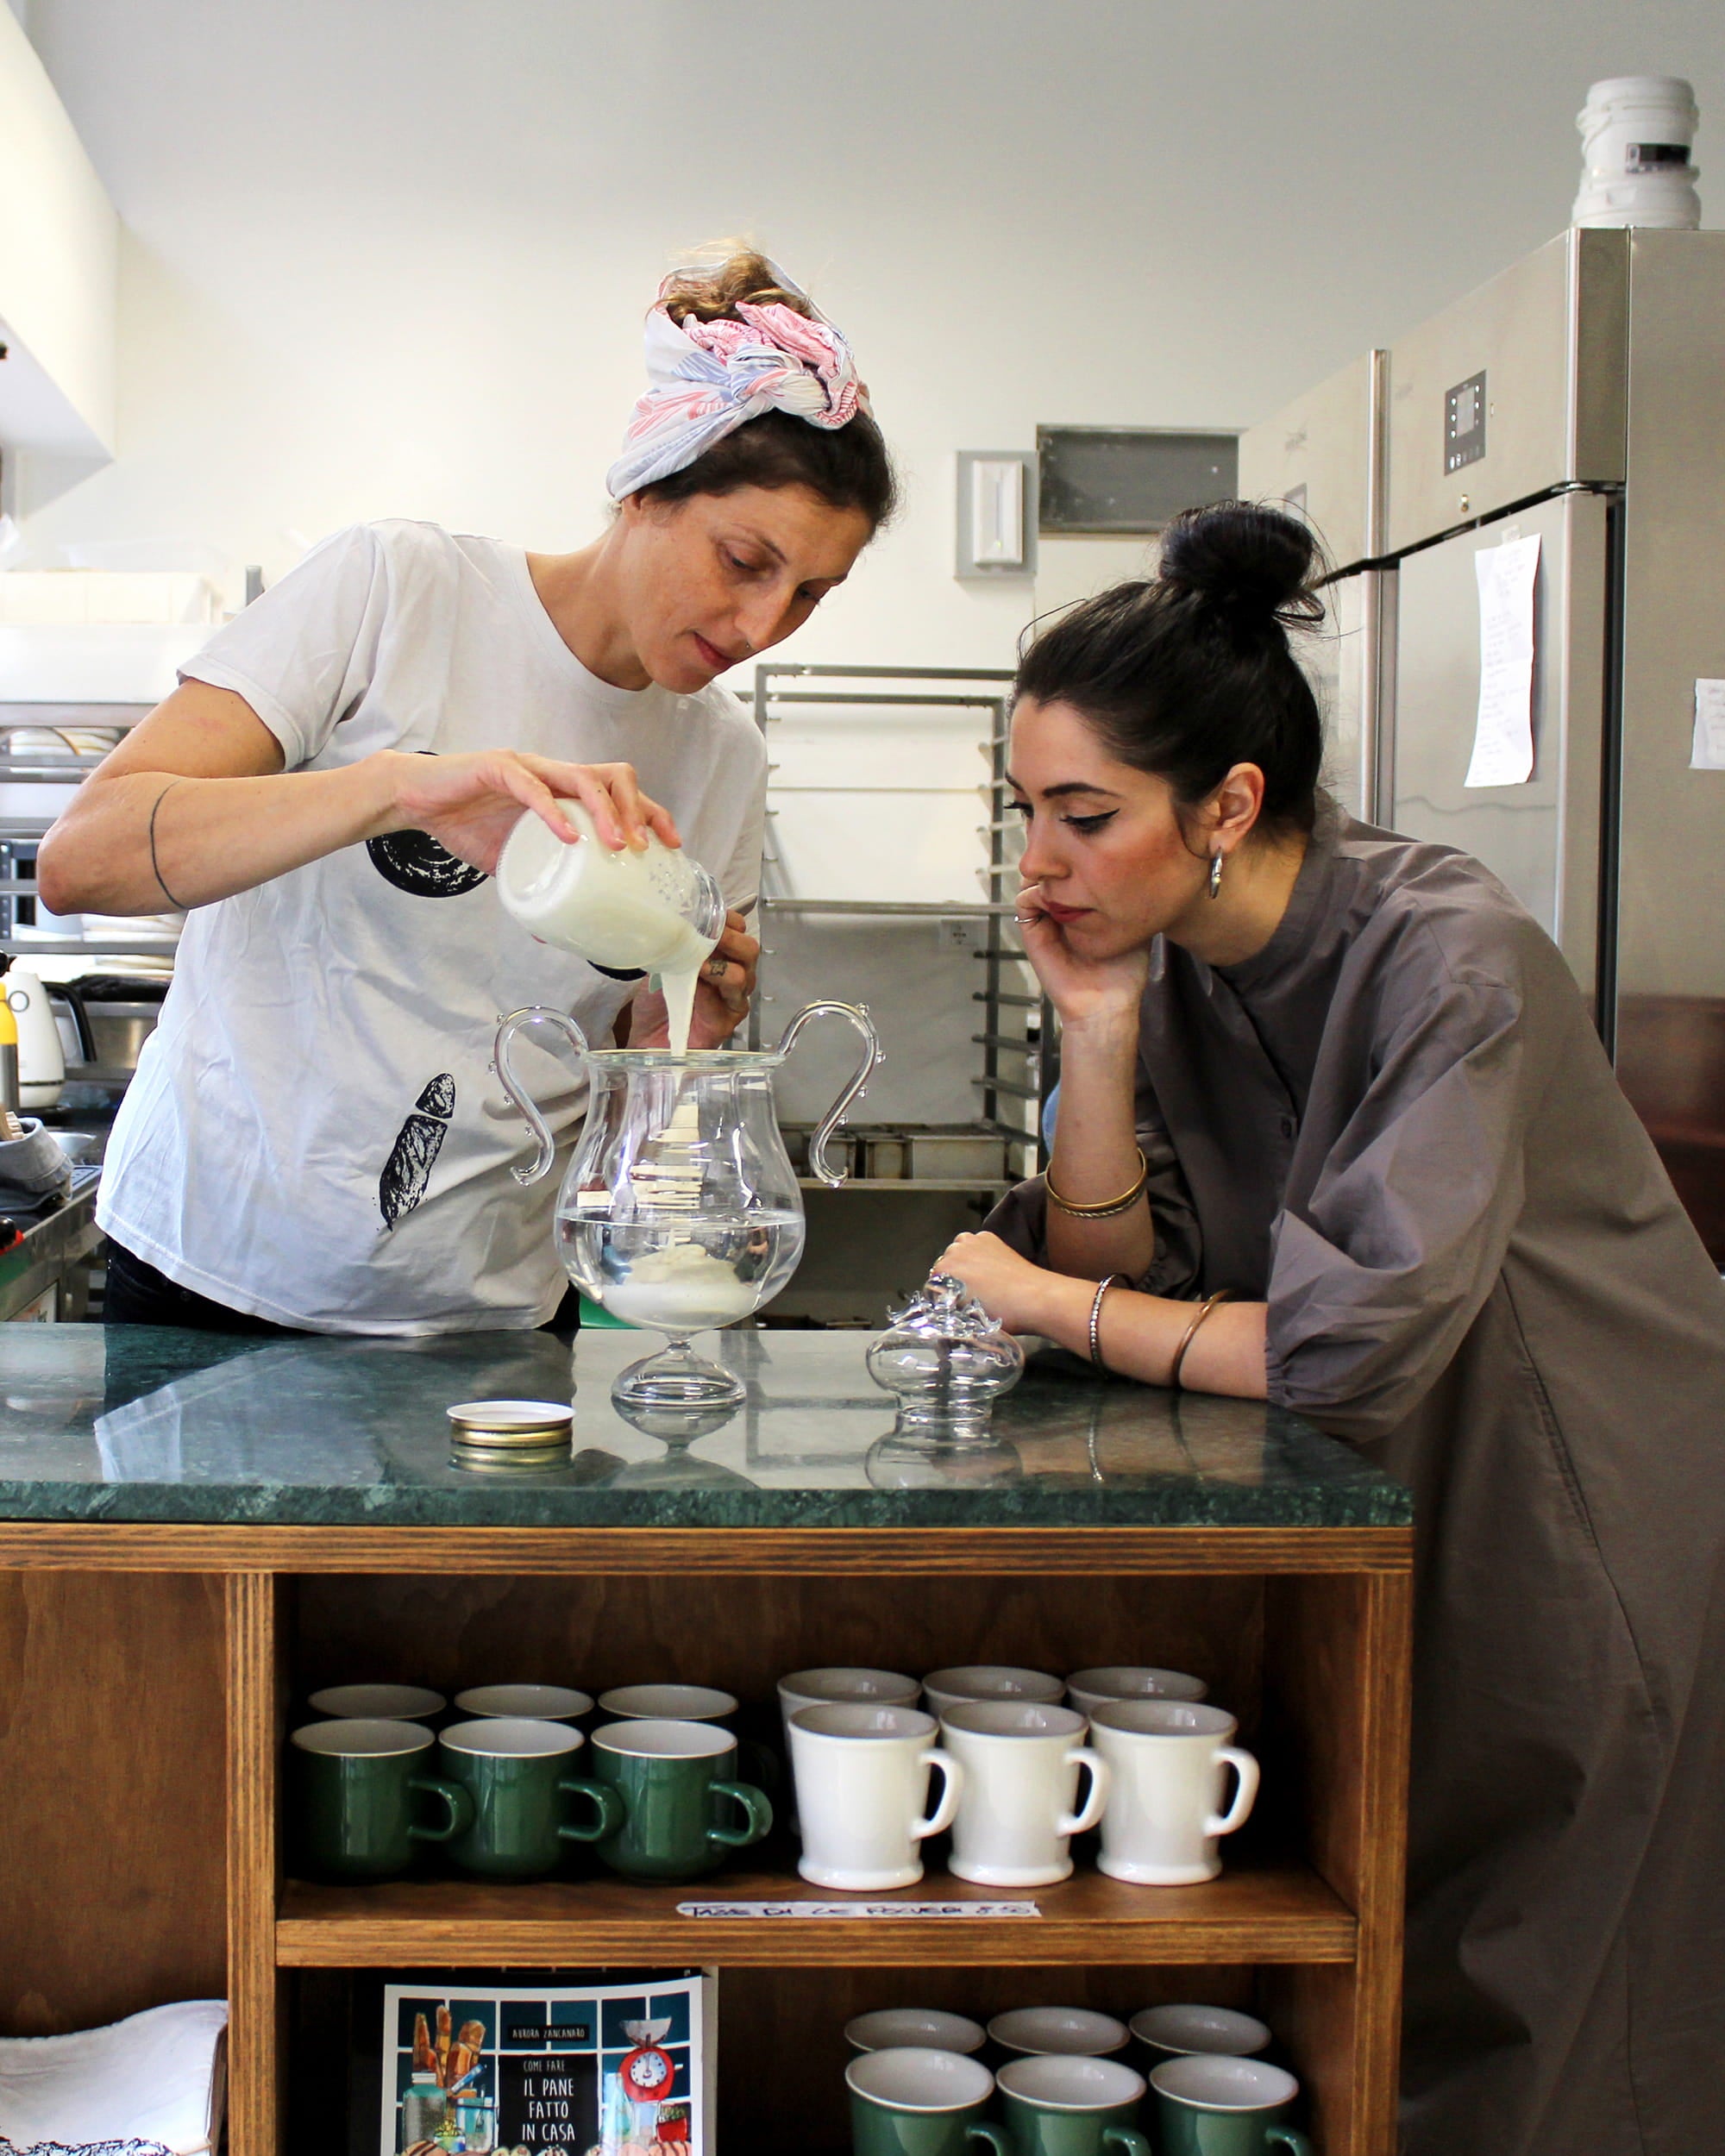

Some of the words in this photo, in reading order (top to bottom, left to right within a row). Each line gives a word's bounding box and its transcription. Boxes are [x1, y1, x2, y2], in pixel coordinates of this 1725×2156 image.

[512, 2028, 540, 2040] AURORA
[543, 2028, 586, 2039] ZANCANARO
[523, 2059, 542, 2072] COME
[546, 2059, 565, 2072] FARE
[524, 2078, 535, 2096] IL
[543, 2078, 574, 2096] PANE
[529, 2101, 569, 2119] FATTO
[522, 2123, 536, 2141] IN
[542, 2123, 576, 2141] CASA
